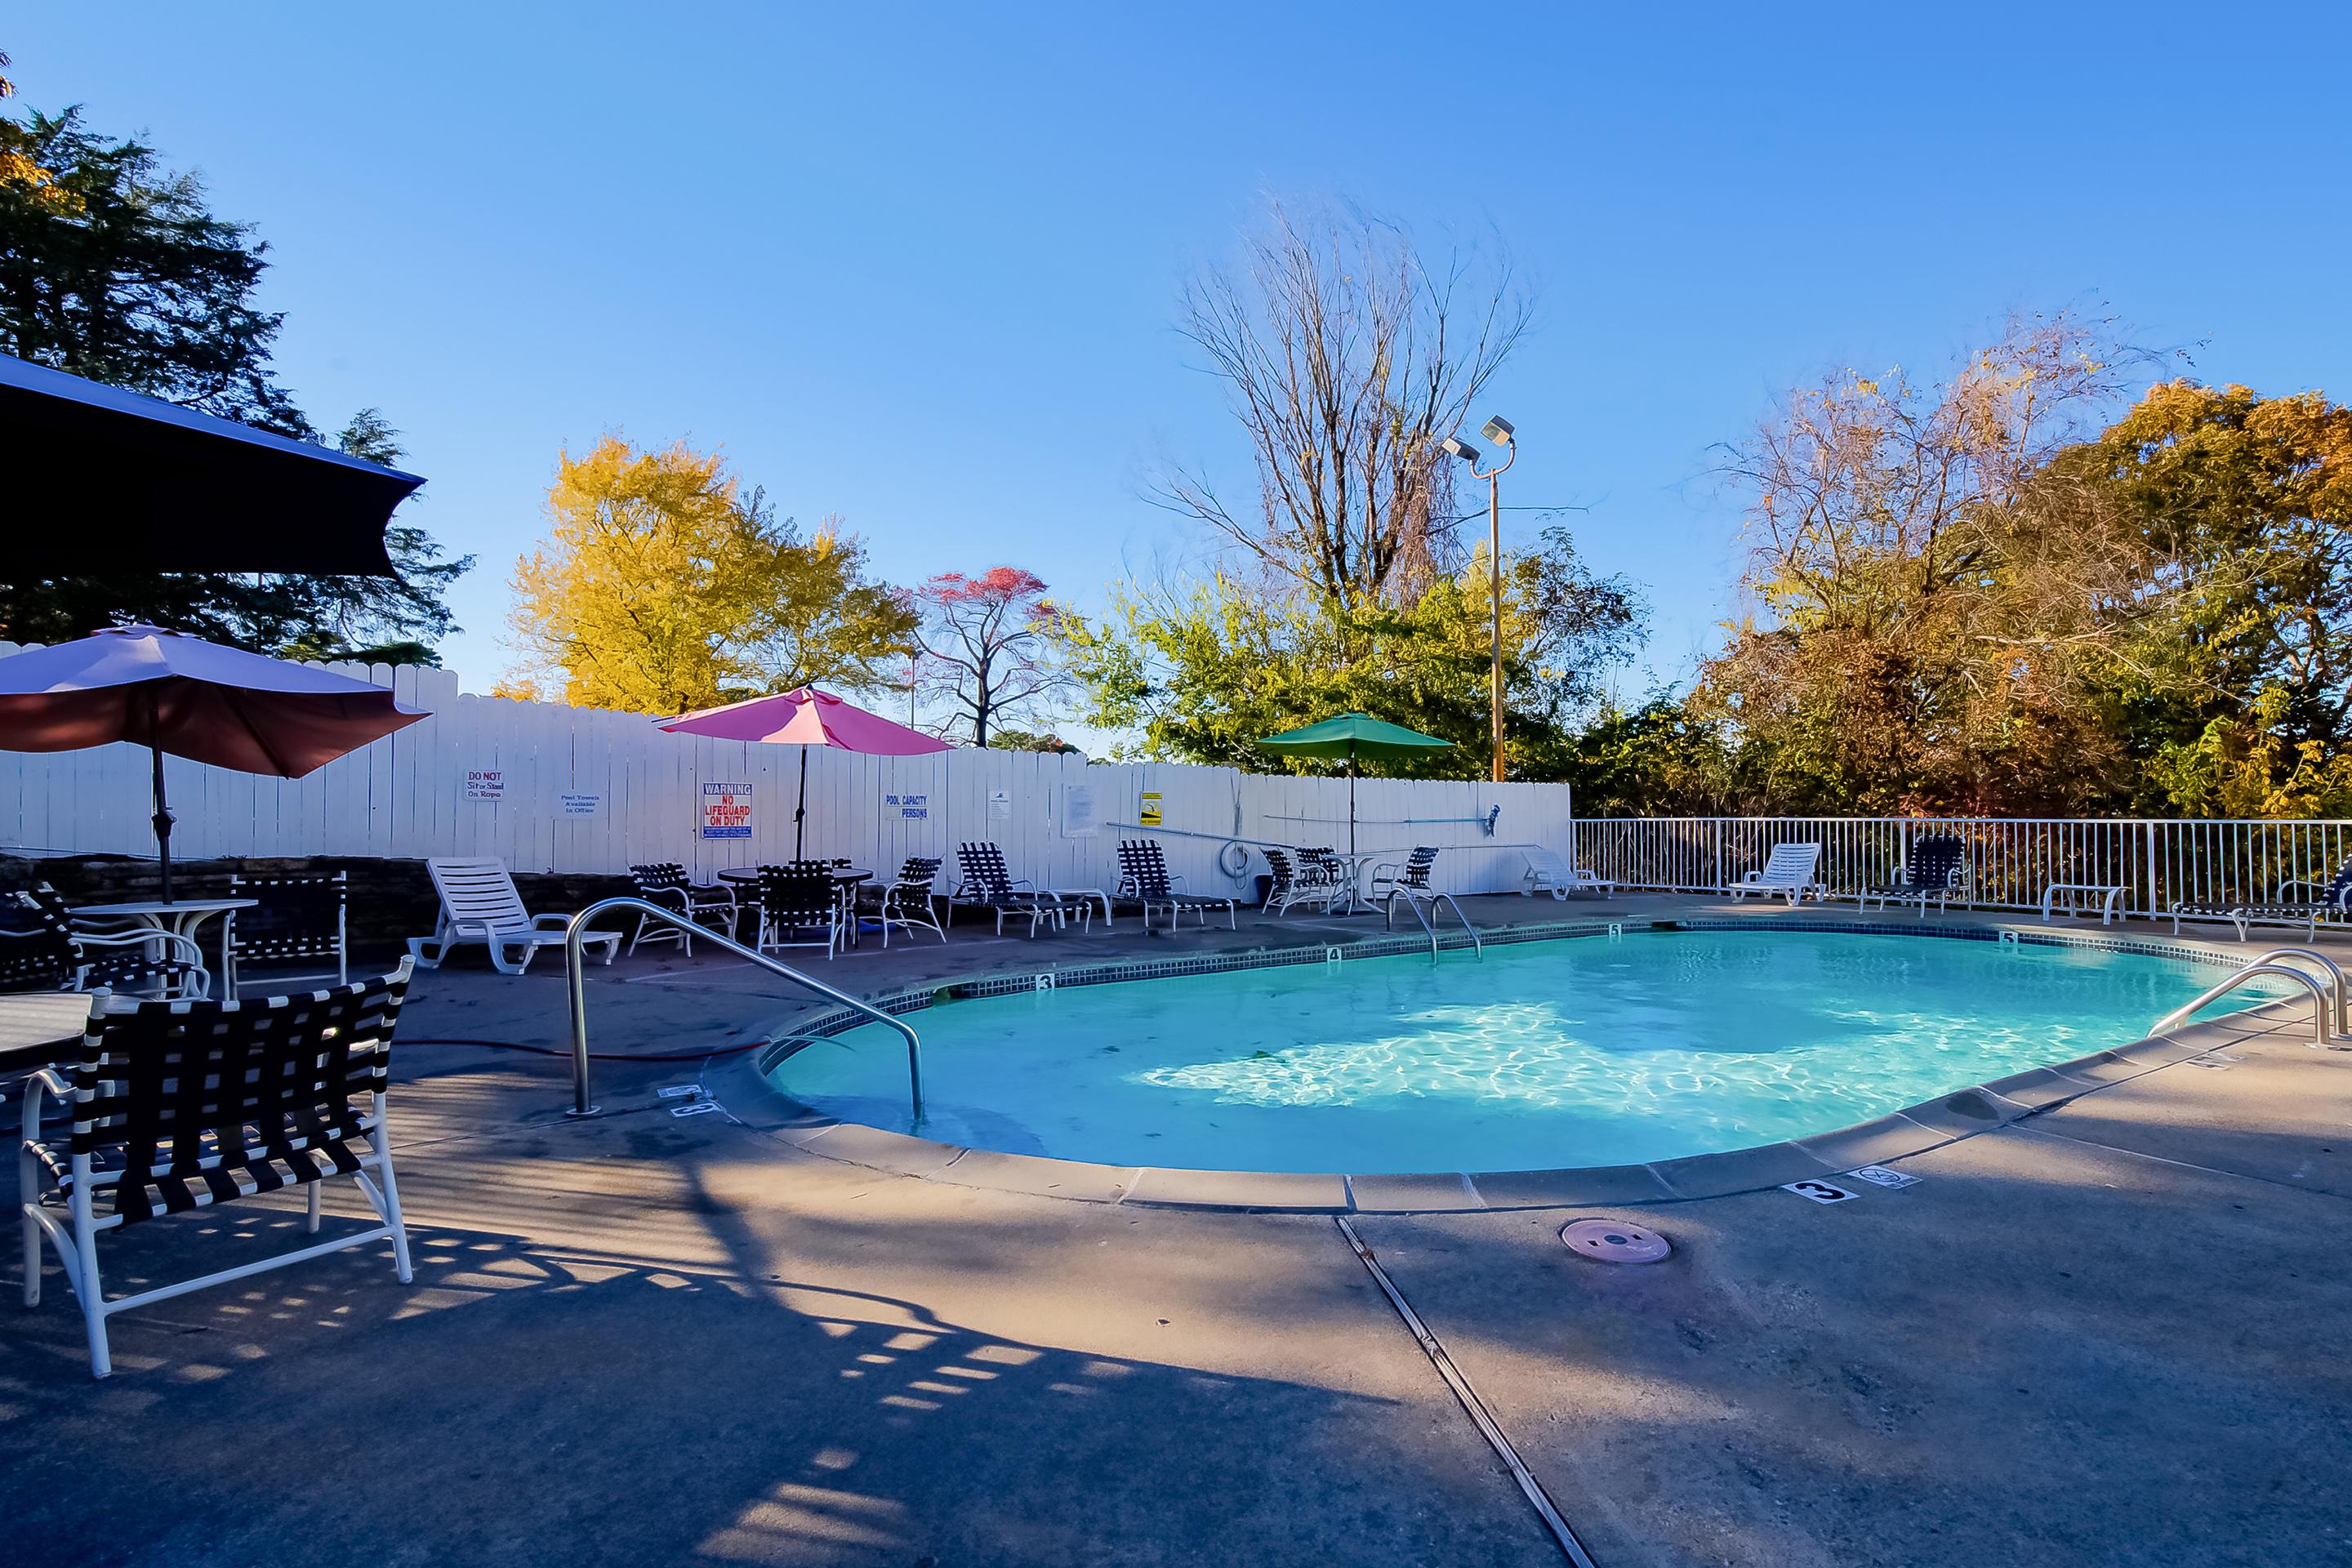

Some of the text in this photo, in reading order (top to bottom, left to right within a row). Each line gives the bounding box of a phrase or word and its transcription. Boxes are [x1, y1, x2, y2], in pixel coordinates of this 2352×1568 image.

[469, 772, 501, 781] DO NOT
[705, 784, 751, 795] WARNING
[722, 795, 734, 805] NO
[886, 795, 927, 805] POOL CAPACITY
[705, 805, 751, 816] LIFEGUARD
[902, 808, 928, 818] PERSONS
[710, 816, 745, 826] ON DUTY
[1610, 924, 1619, 936] 5
[2003, 933, 2014, 942] 5
[1330, 948, 1339, 960] 4
[1039, 975, 1053, 990] 3
[1794, 1182, 1846, 1200] 3
